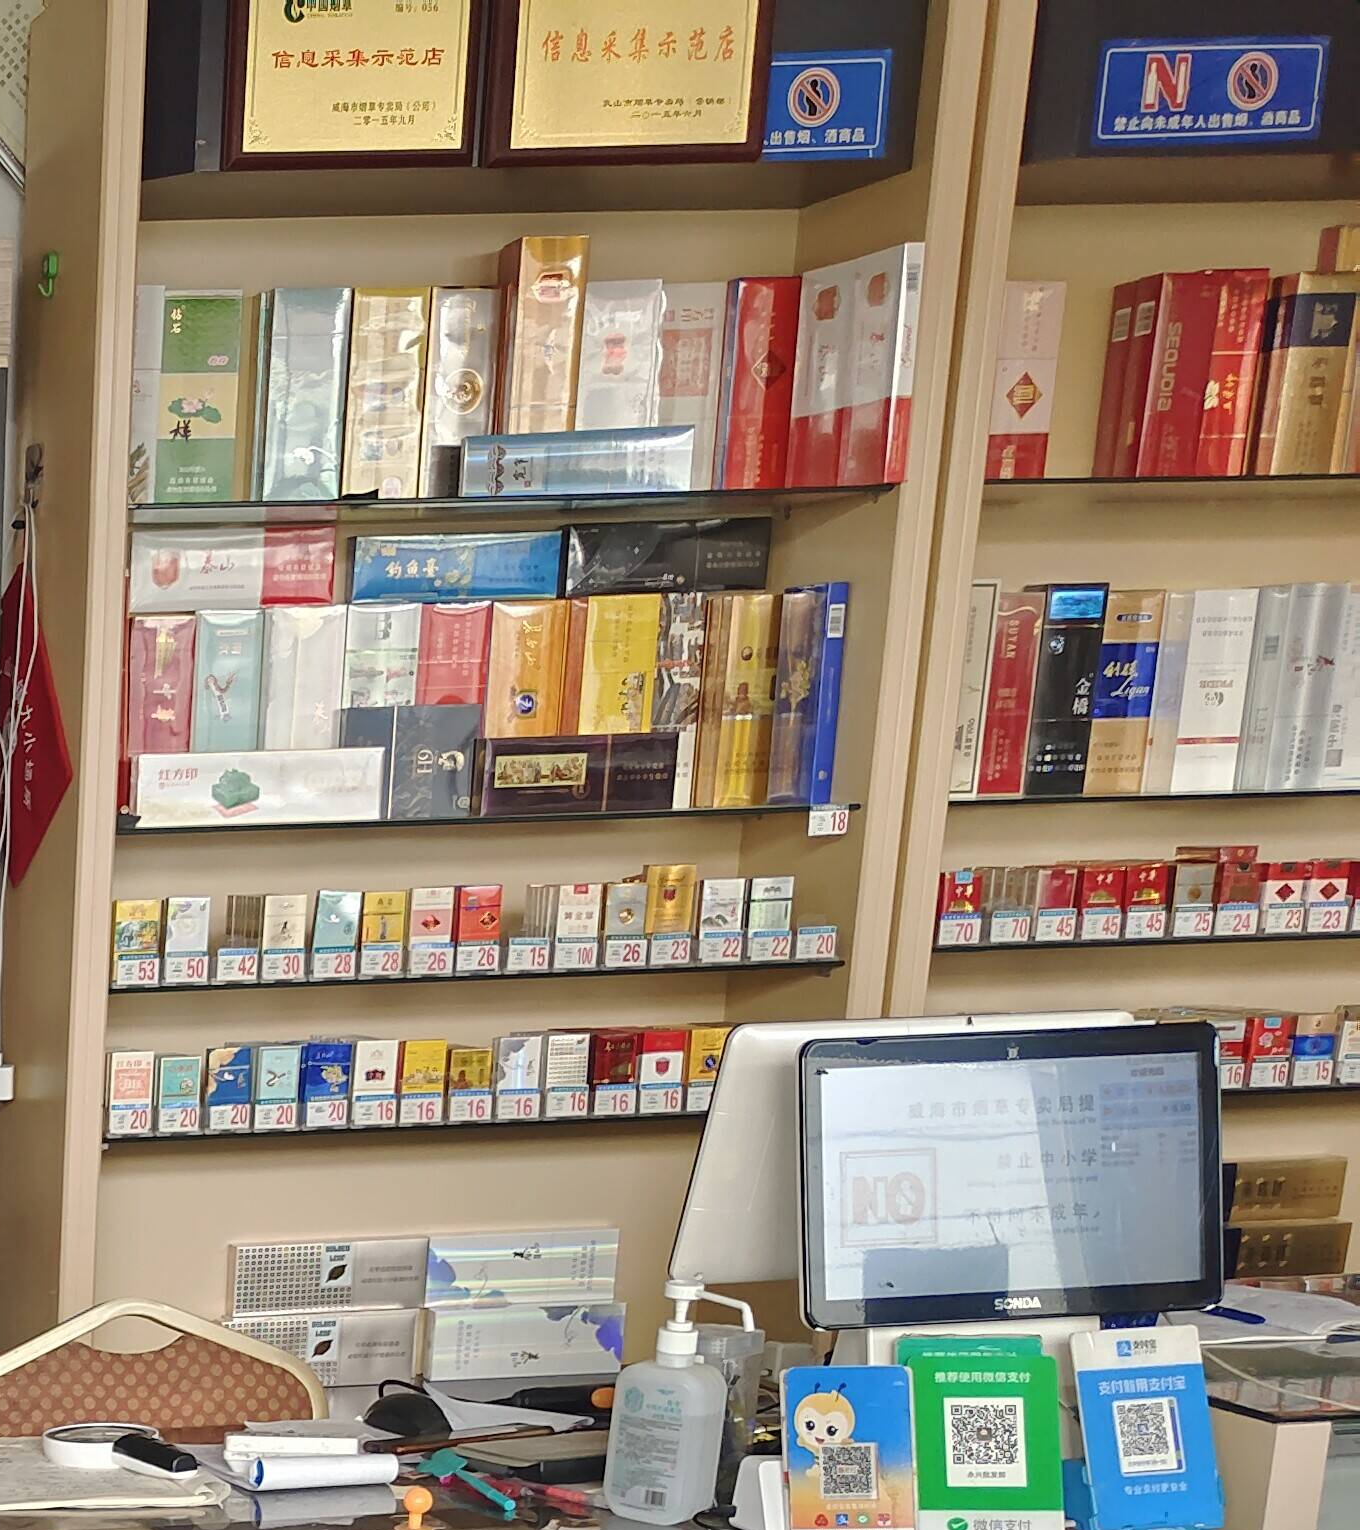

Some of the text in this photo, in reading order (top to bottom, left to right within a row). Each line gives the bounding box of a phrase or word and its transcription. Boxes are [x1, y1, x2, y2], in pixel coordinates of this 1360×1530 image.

[542, 25, 736, 64] 信息采集示范店
[271, 48, 446, 69] 信息采集示范店
[829, 810, 847, 833] 18
[1011, 918, 1028, 939] 70
[1056, 916, 1073, 937] 45
[1101, 915, 1119, 936] 45
[1145, 911, 1163, 932] 45
[1194, 911, 1211, 932] 25
[1232, 912, 1251, 933] 24
[1284, 909, 1302, 930] 23
[1323, 909, 1341, 930] 23
[954, 922, 973, 943] 70
[622, 942, 641, 963] 26
[671, 940, 689, 960] 23
[722, 938, 739, 959] 22
[771, 936, 789, 957] 22
[816, 934, 834, 954] 20
[237, 955, 255, 976] 42
[282, 955, 300, 977] 30
[334, 953, 351, 974] 28
[381, 952, 399, 973] 28
[427, 951, 447, 973] 26
[477, 947, 495, 968] 26
[530, 946, 546, 967] 15
[576, 946, 593, 965] 100
[137, 960, 156, 981] 53
[186, 957, 205, 979] 50
[1226, 1064, 1243, 1085] 16
[1272, 1063, 1286, 1083] 16
[1314, 1060, 1330, 1081] 15
[466, 1099, 485, 1118] 16
[514, 1097, 533, 1116] 16
[569, 1092, 586, 1111] 16
[611, 1093, 628, 1112] 16
[663, 1090, 678, 1109] 16
[130, 1109, 148, 1129] 20
[180, 1107, 197, 1127] 20
[230, 1105, 248, 1125] 20
[276, 1105, 293, 1125] 20
[328, 1101, 344, 1121] 20
[376, 1102, 393, 1120] 16
[417, 1101, 435, 1120] 16
[933, 1371, 1032, 1384] 推荐使用微信支付
